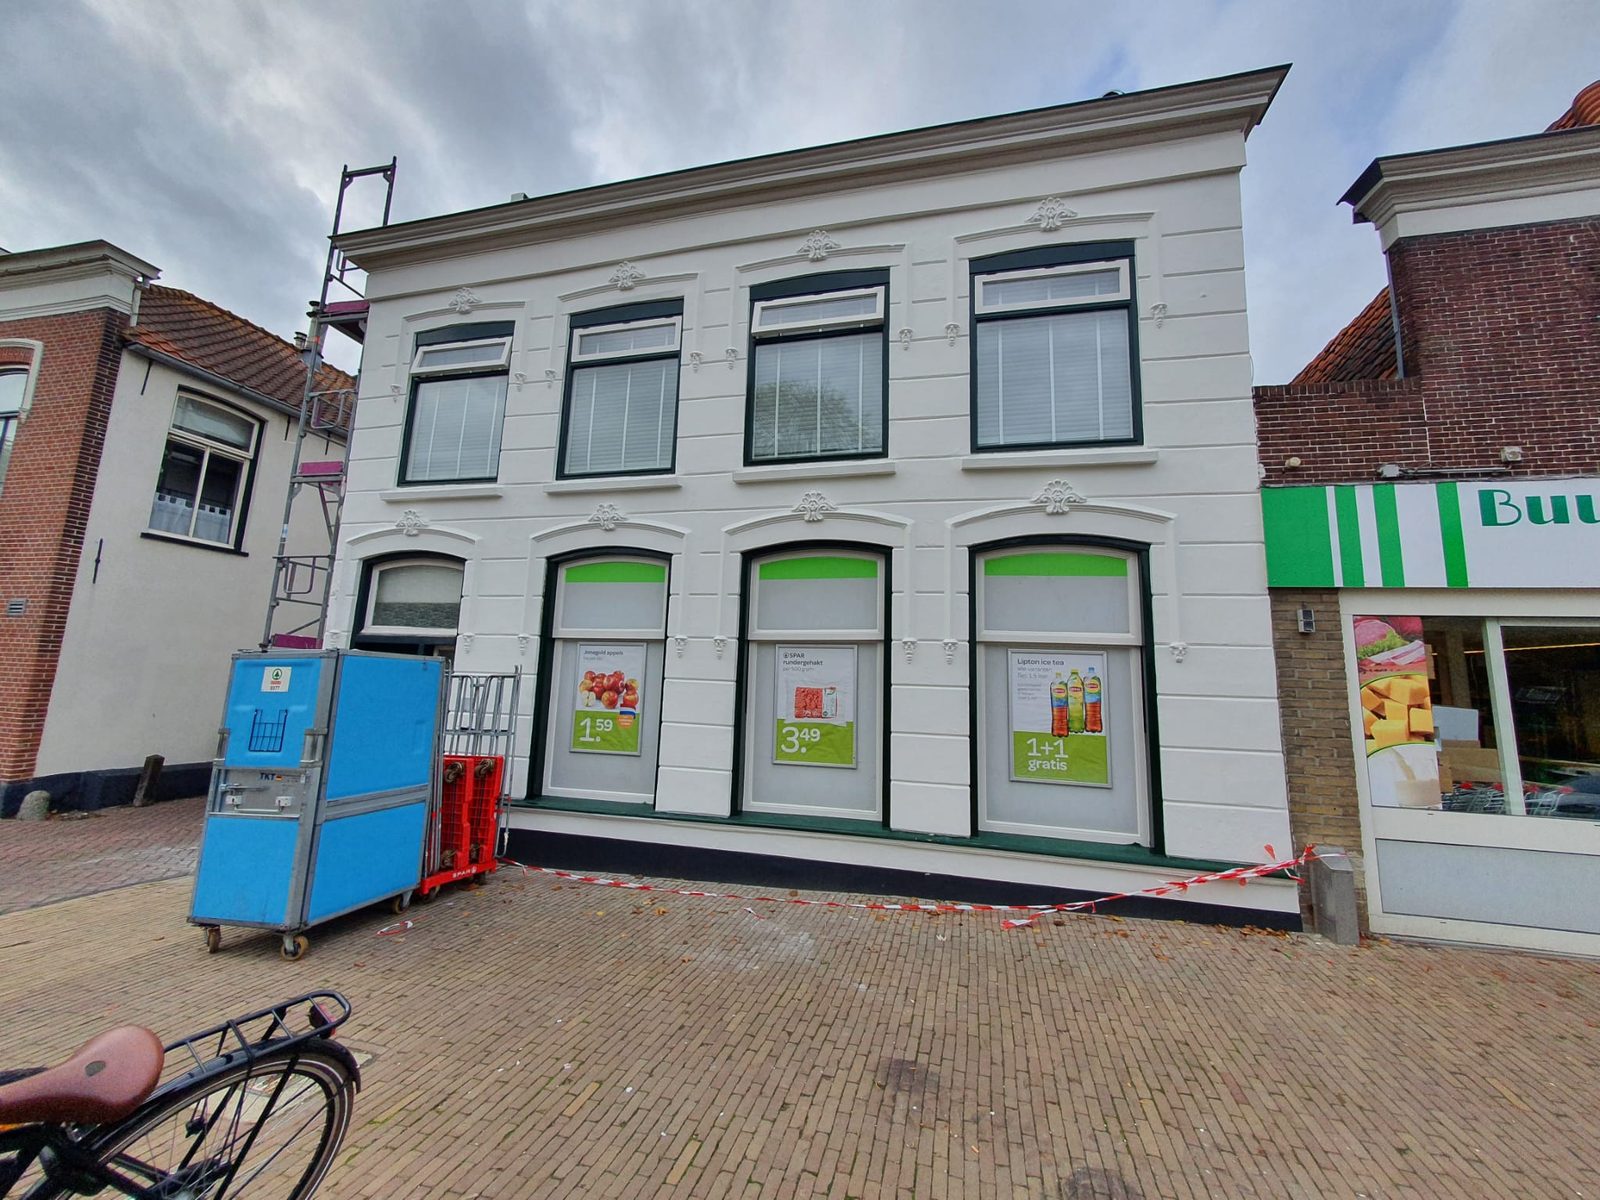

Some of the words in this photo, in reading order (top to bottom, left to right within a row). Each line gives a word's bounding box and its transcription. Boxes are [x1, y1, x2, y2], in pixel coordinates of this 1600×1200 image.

[1026, 738, 1068, 758] 1+1
[1028, 758, 1067, 771] gratis
[260, 772, 276, 780] TKT
